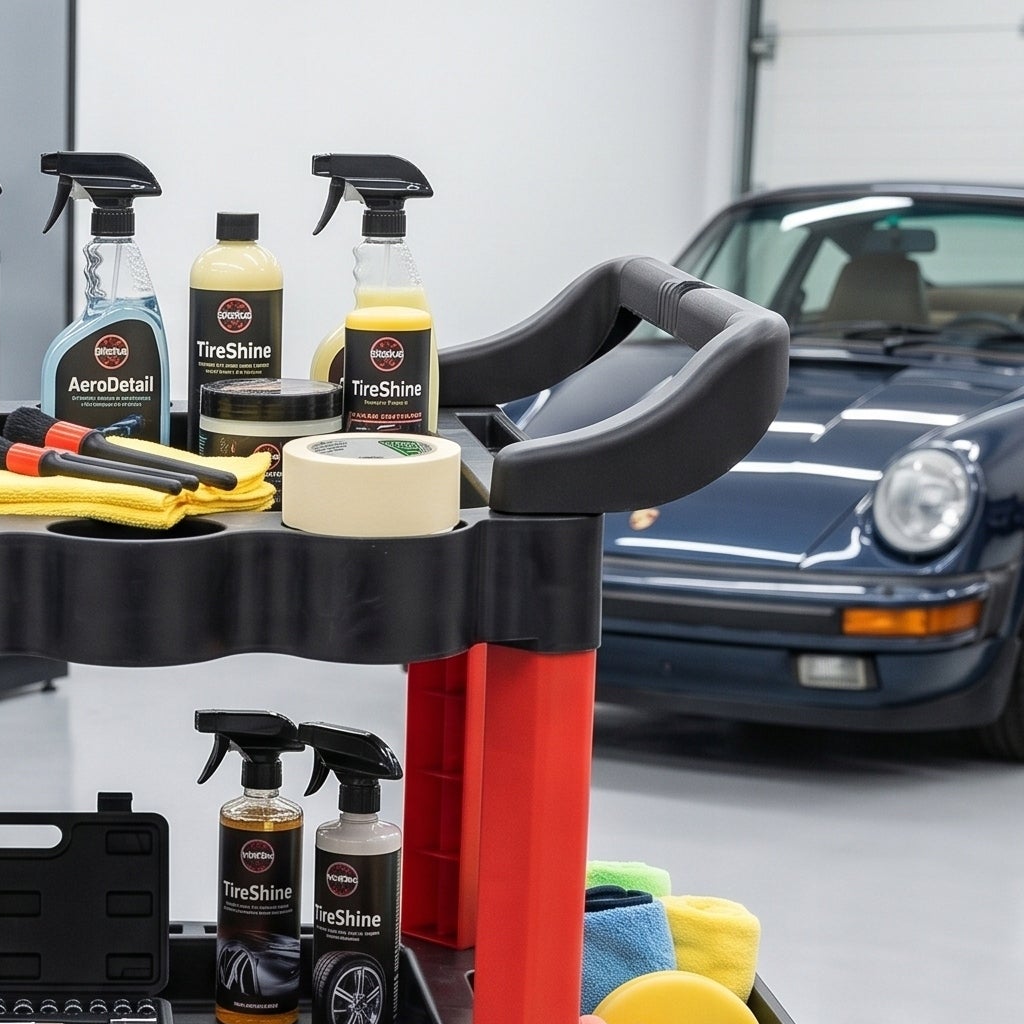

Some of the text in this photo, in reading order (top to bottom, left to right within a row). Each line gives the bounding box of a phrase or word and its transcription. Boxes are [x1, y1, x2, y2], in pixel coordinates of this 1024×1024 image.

[196, 340, 271, 360] TireShine
[68, 375, 154, 393] AeroDetail
[352, 379, 422, 398] TireShine
[223, 879, 292, 902] TireShine
[314, 903, 381, 928] TireShine
